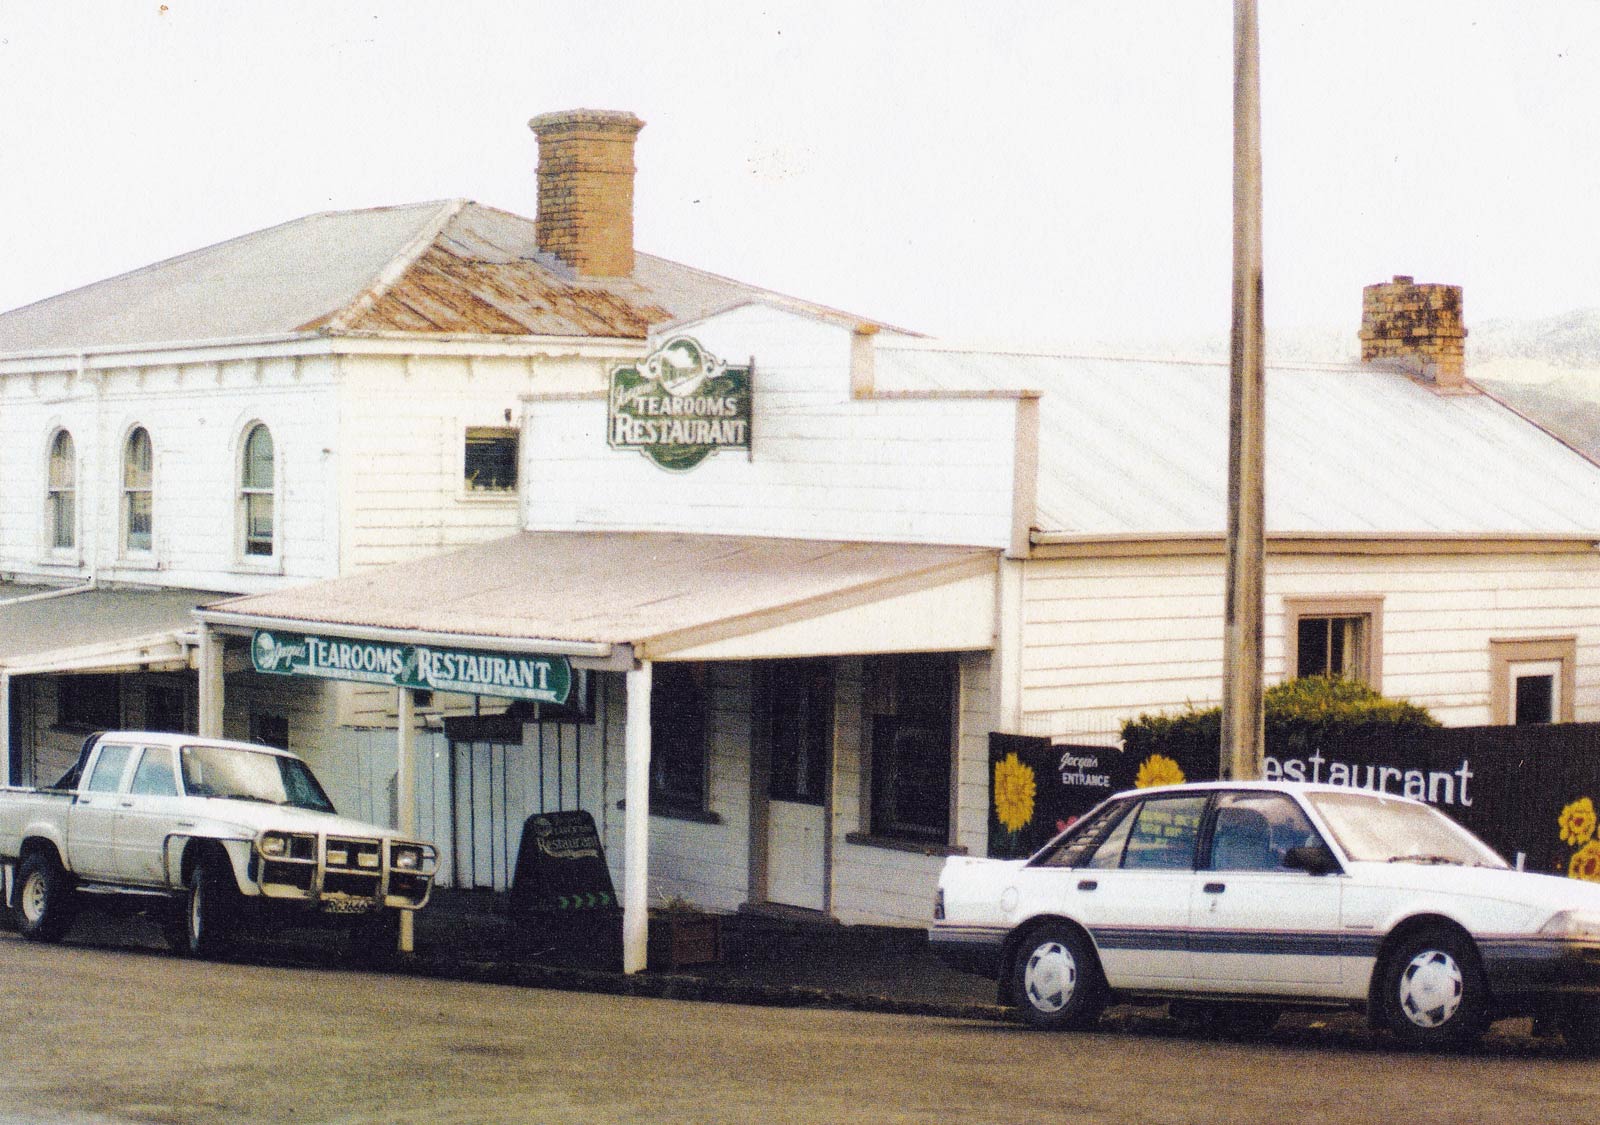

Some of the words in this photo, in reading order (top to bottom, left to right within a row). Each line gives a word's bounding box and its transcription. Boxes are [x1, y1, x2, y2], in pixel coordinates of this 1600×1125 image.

[637, 397, 738, 416] TEAROOMS
[615, 413, 747, 445] RESTAURANT
[304, 637, 403, 675] TEAROOMS
[417, 647, 550, 690] RESTAURANT
[1062, 772, 1111, 787] ENTRANCE
[1262, 748, 1474, 807] estaurant
